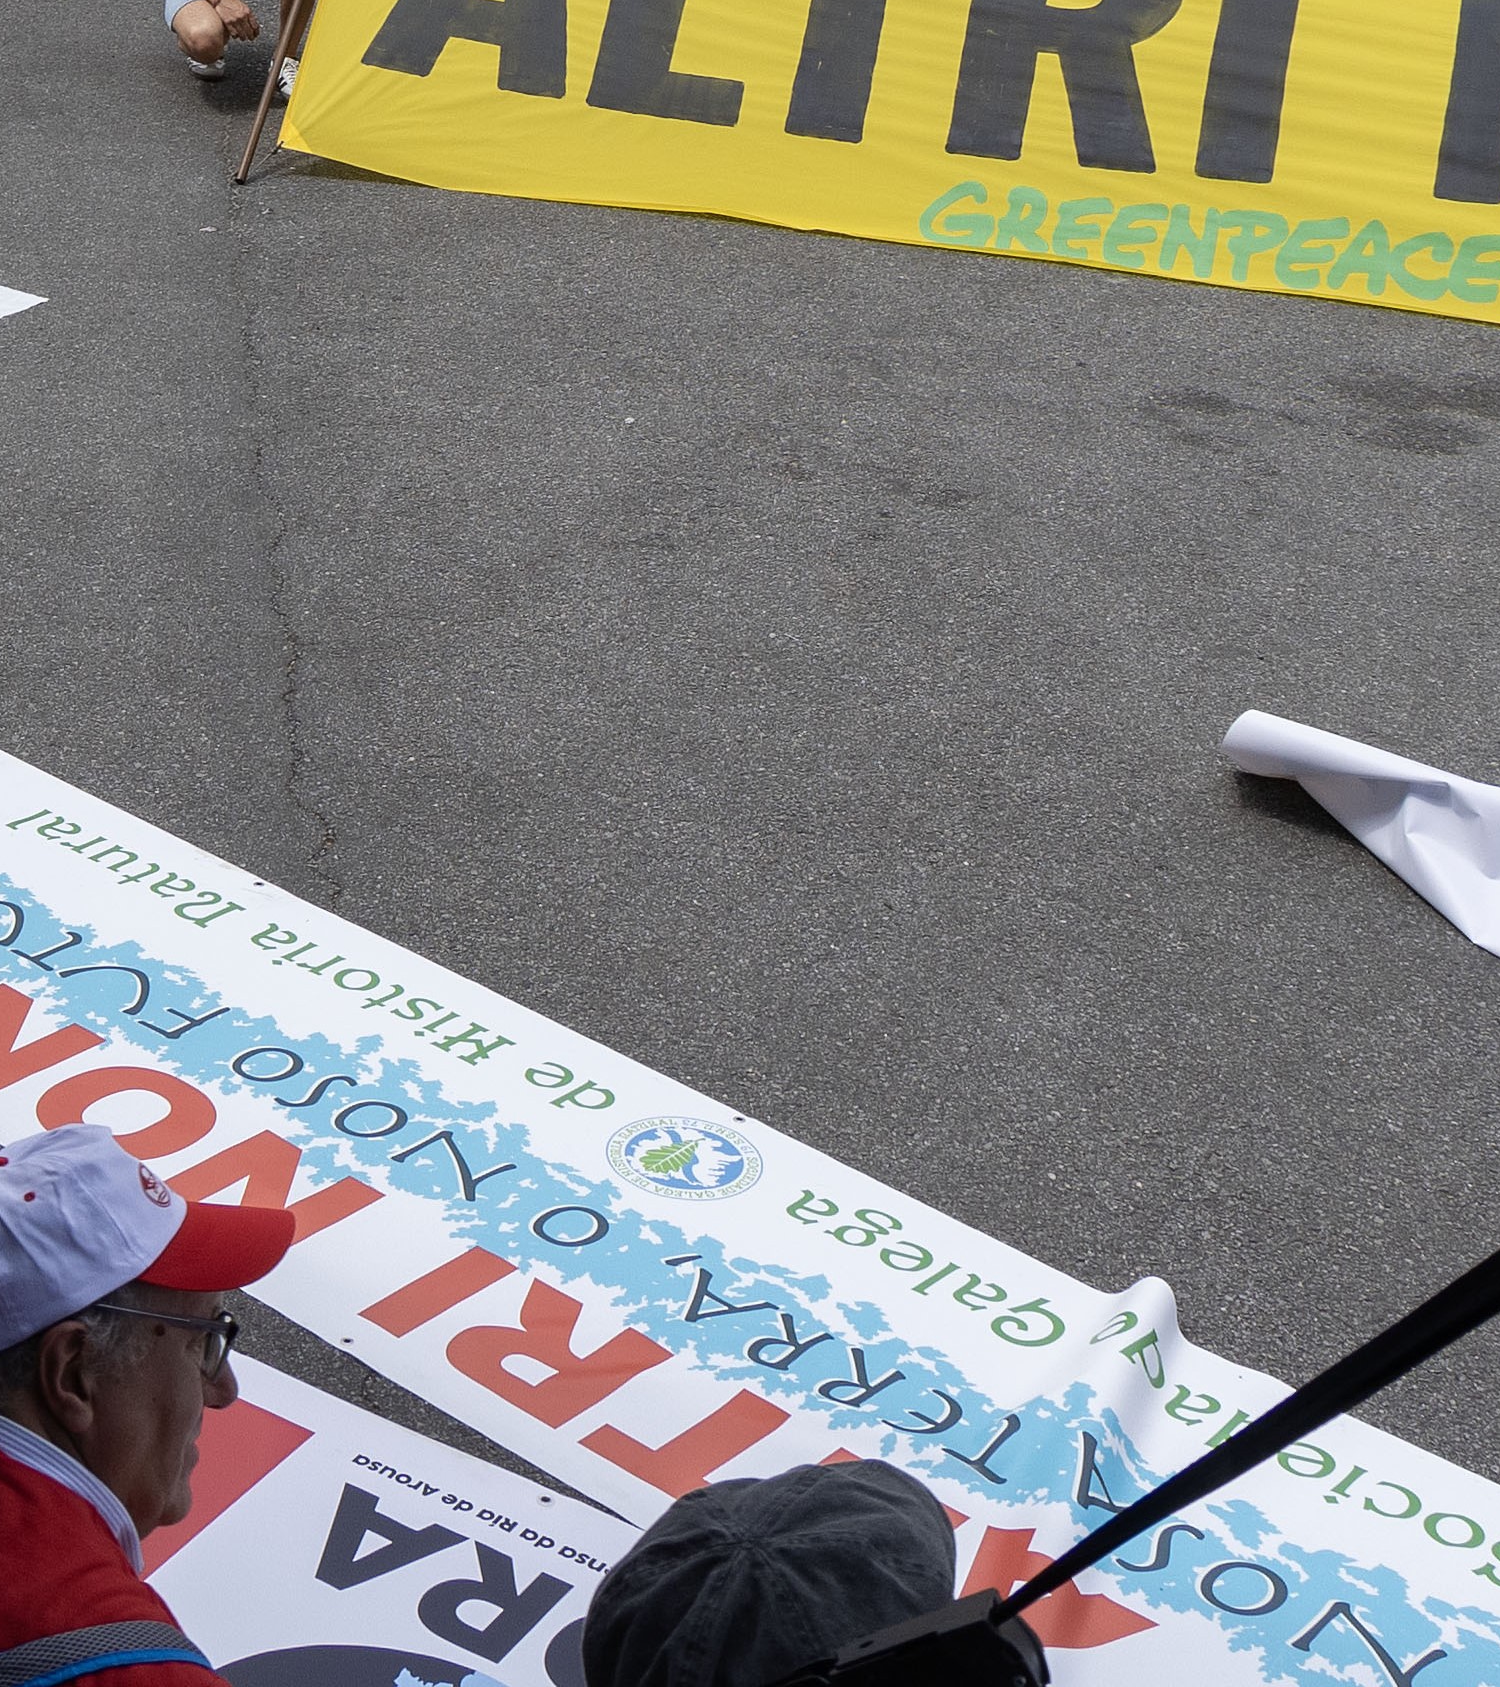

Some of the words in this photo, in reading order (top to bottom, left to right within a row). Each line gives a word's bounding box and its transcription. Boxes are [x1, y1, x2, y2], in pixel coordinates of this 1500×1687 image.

[7, 807, 246, 930] Natural
[249, 922, 515, 1064] Historia
[522, 1060, 618, 1114] de
[230, 1047, 516, 1203] NOSO
[530, 1206, 611, 1247] O
[785, 1189, 1068, 1348] Galega
[664, 1255, 1021, 1486] TERRA,
[351, 1452, 440, 1500] Arousa
[439, 1492, 475, 1515] de
[475, 1505, 519, 1534] Ría
[518, 1526, 556, 1552] da
